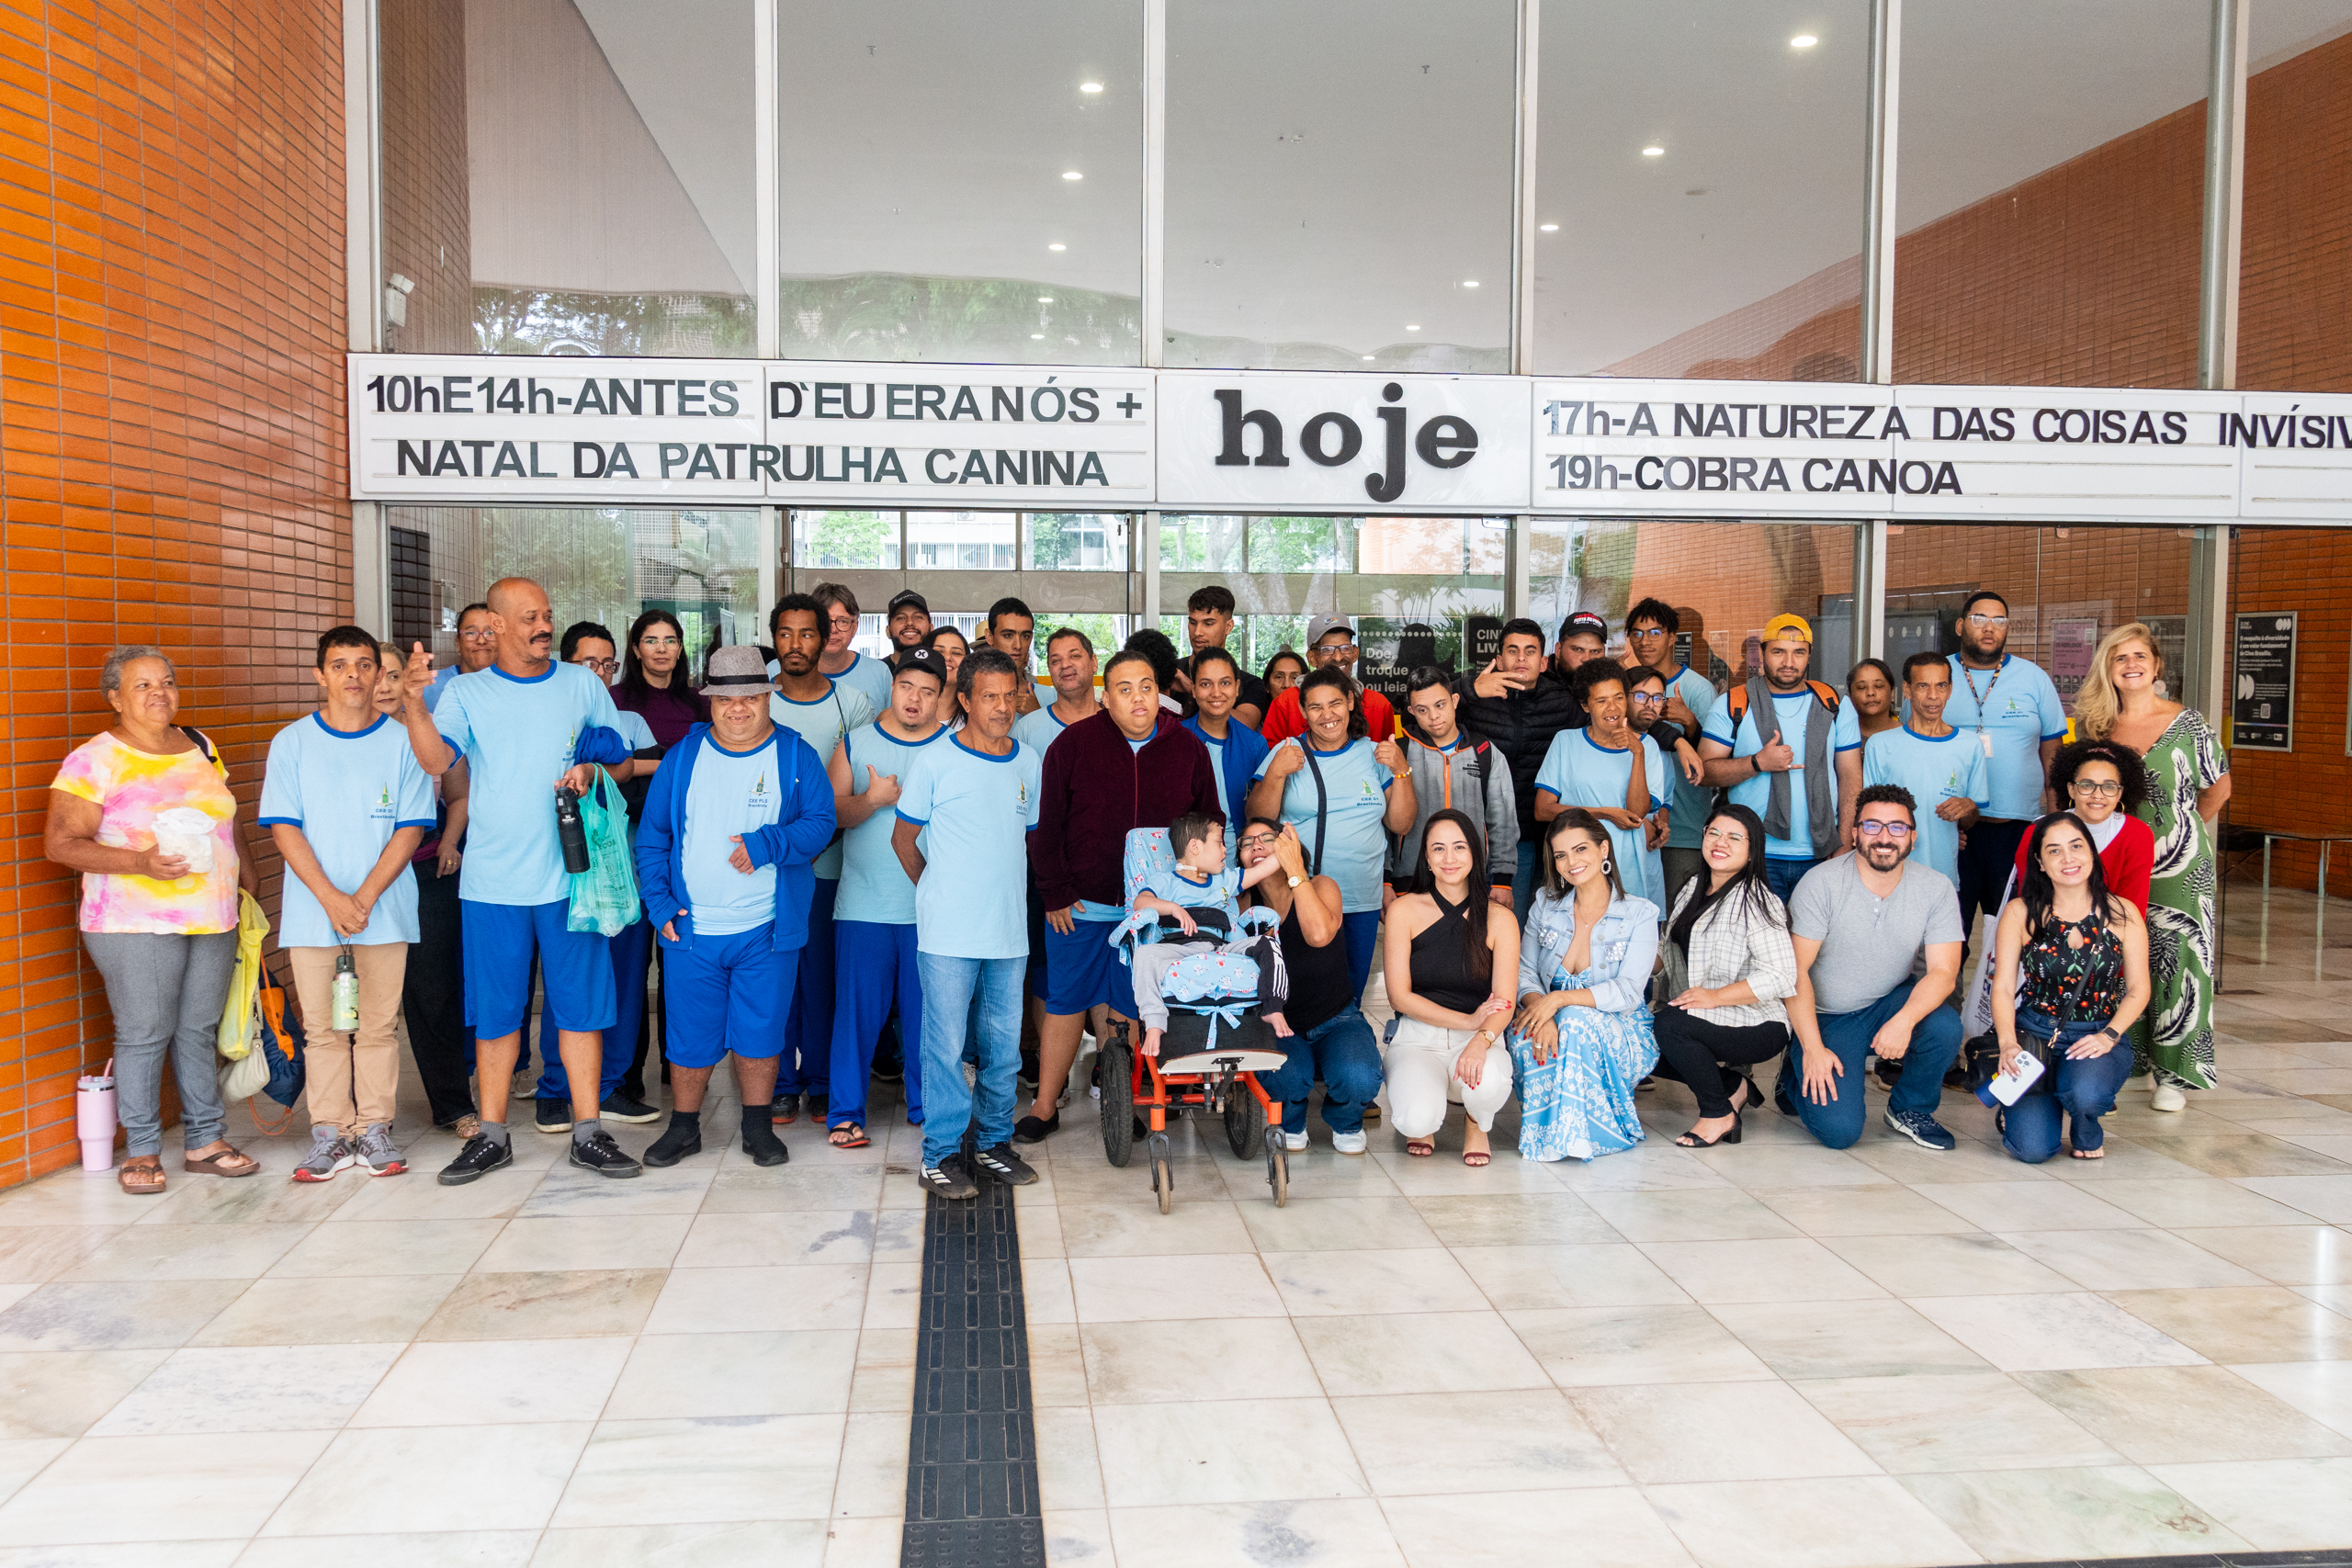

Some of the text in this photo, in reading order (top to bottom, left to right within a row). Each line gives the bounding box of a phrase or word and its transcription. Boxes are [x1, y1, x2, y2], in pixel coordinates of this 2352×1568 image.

[1674, 404, 1910, 441] NATUREZA
[1933, 407, 2015, 443] DAS
[2032, 408, 2188, 445] COISAS
[1214, 382, 1478, 502] hoje
[398, 439, 1109, 487] NATAL DA PATRULHA CANINA
[1549, 455, 1962, 495] 19h-COBRA CANOA
[1366, 648, 1395, 661] Doe,
[1476, 643, 1500, 653] LIV
[1365, 665, 1408, 678] troque
[1385, 682, 1408, 692] leia
